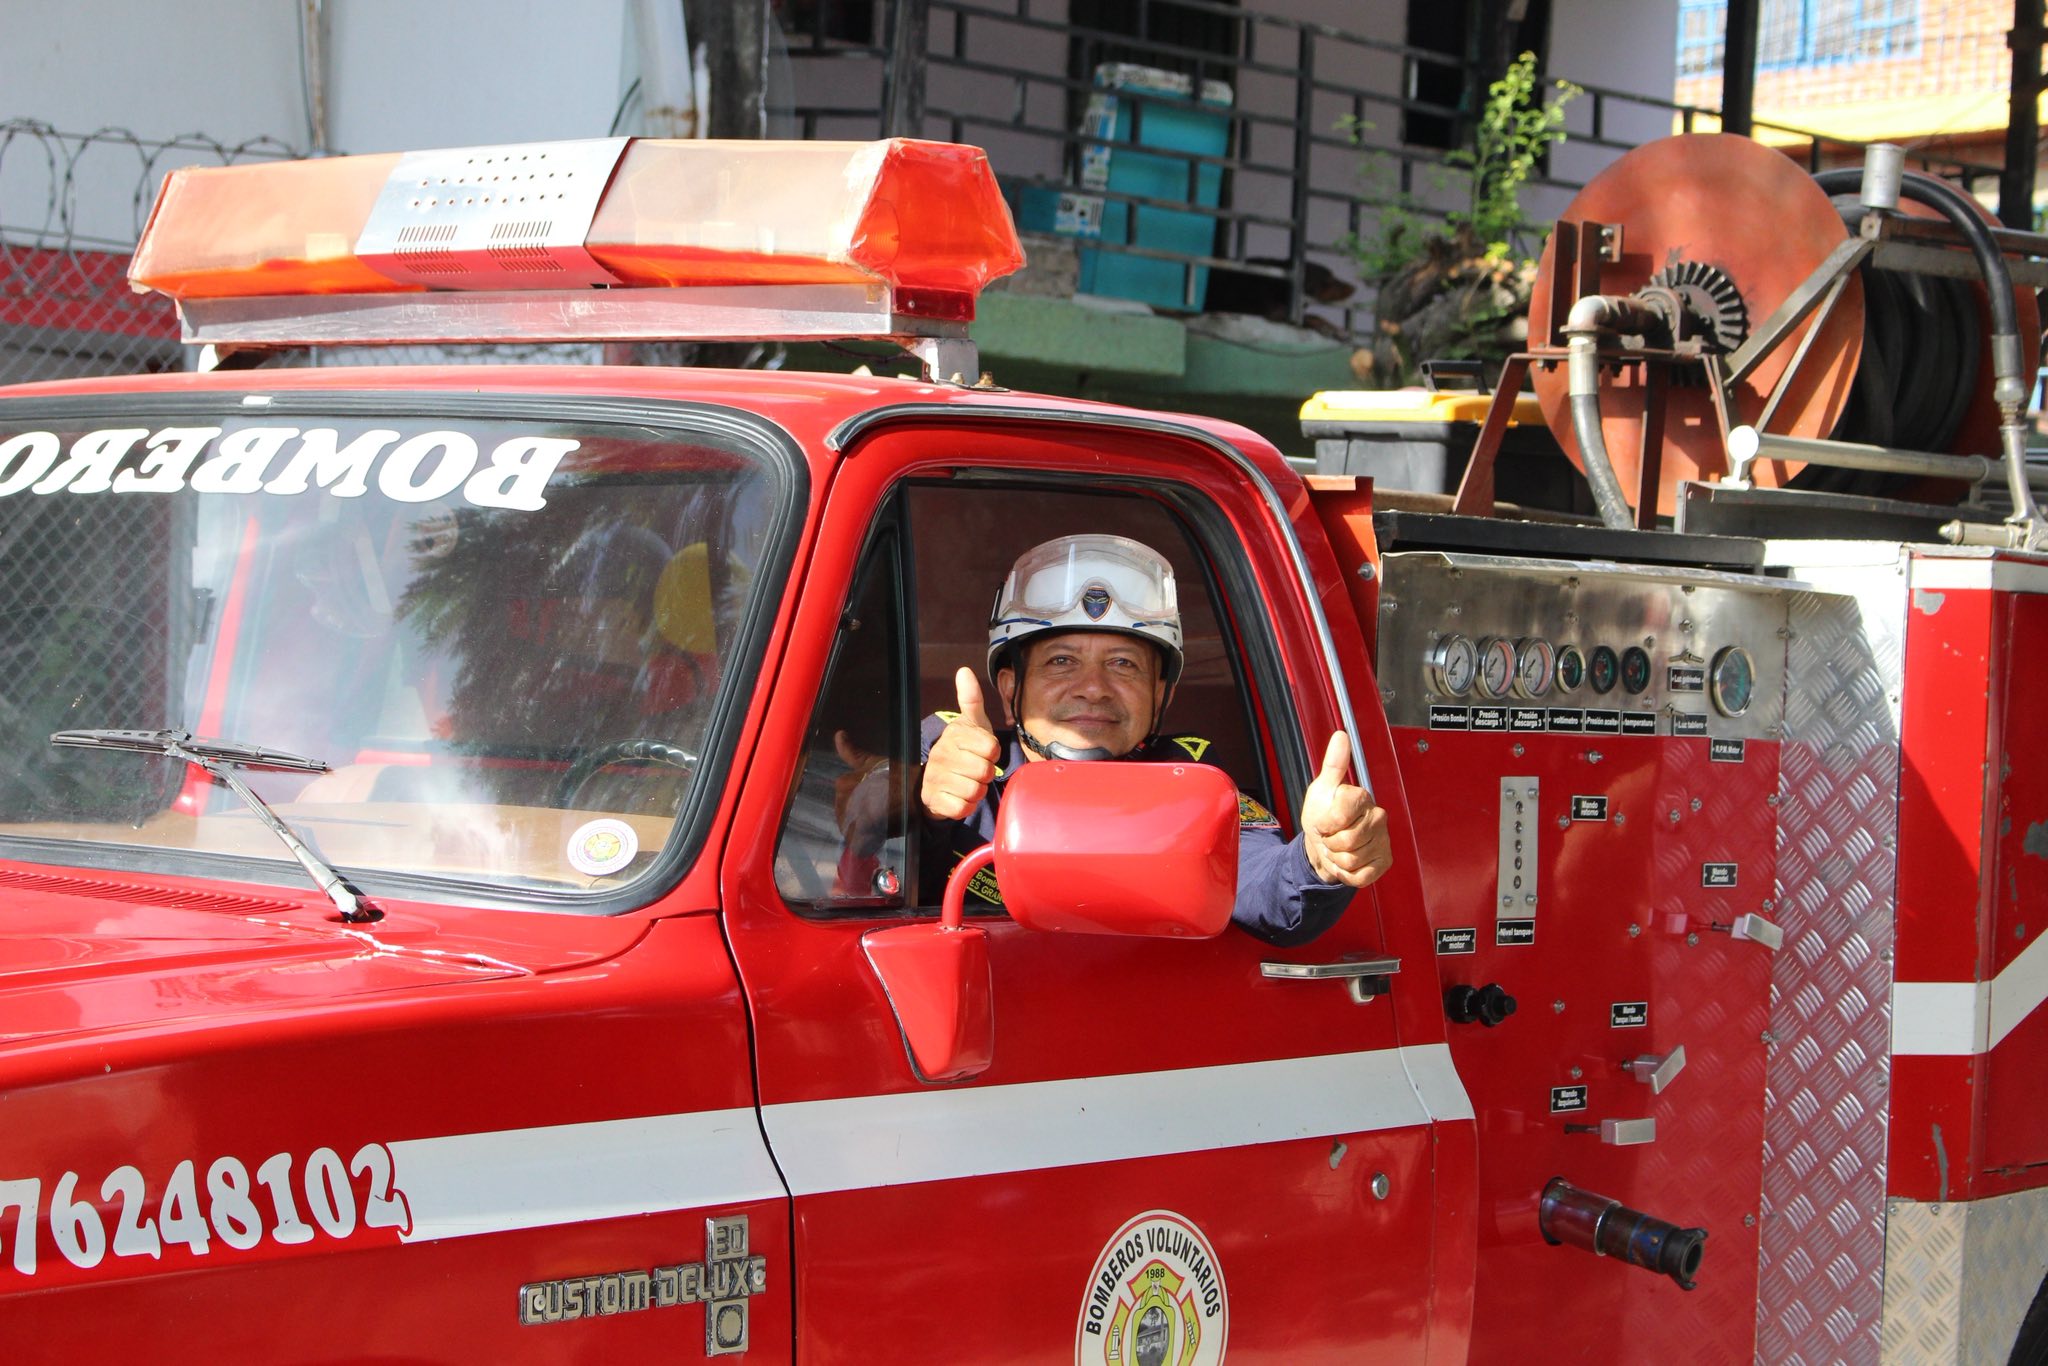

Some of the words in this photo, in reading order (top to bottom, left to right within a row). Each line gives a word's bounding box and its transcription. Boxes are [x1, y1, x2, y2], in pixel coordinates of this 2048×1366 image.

[1479, 710, 1499, 719] Presión
[1518, 711, 1538, 720] Presión
[1475, 717, 1498, 728] descarga
[1514, 718, 1538, 728] descarga
[1581, 800, 1599, 809] Mando
[975, 871, 1001, 890] Bomb
[981, 886, 1005, 903] GRAN
[1442, 933, 1471, 942] Acelerador
[1448, 941, 1465, 950] motor
[1560, 1089, 1578, 1098] Mando
[0, 1143, 411, 1276] 76248102
[715, 1223, 746, 1255] 30
[1145, 1268, 1166, 1279] 1988
[1085, 1233, 1144, 1336] BOMBEROS
[1146, 1227, 1221, 1318] VOLUNTARIOS
[520, 1270, 651, 1326] CUSTOM
